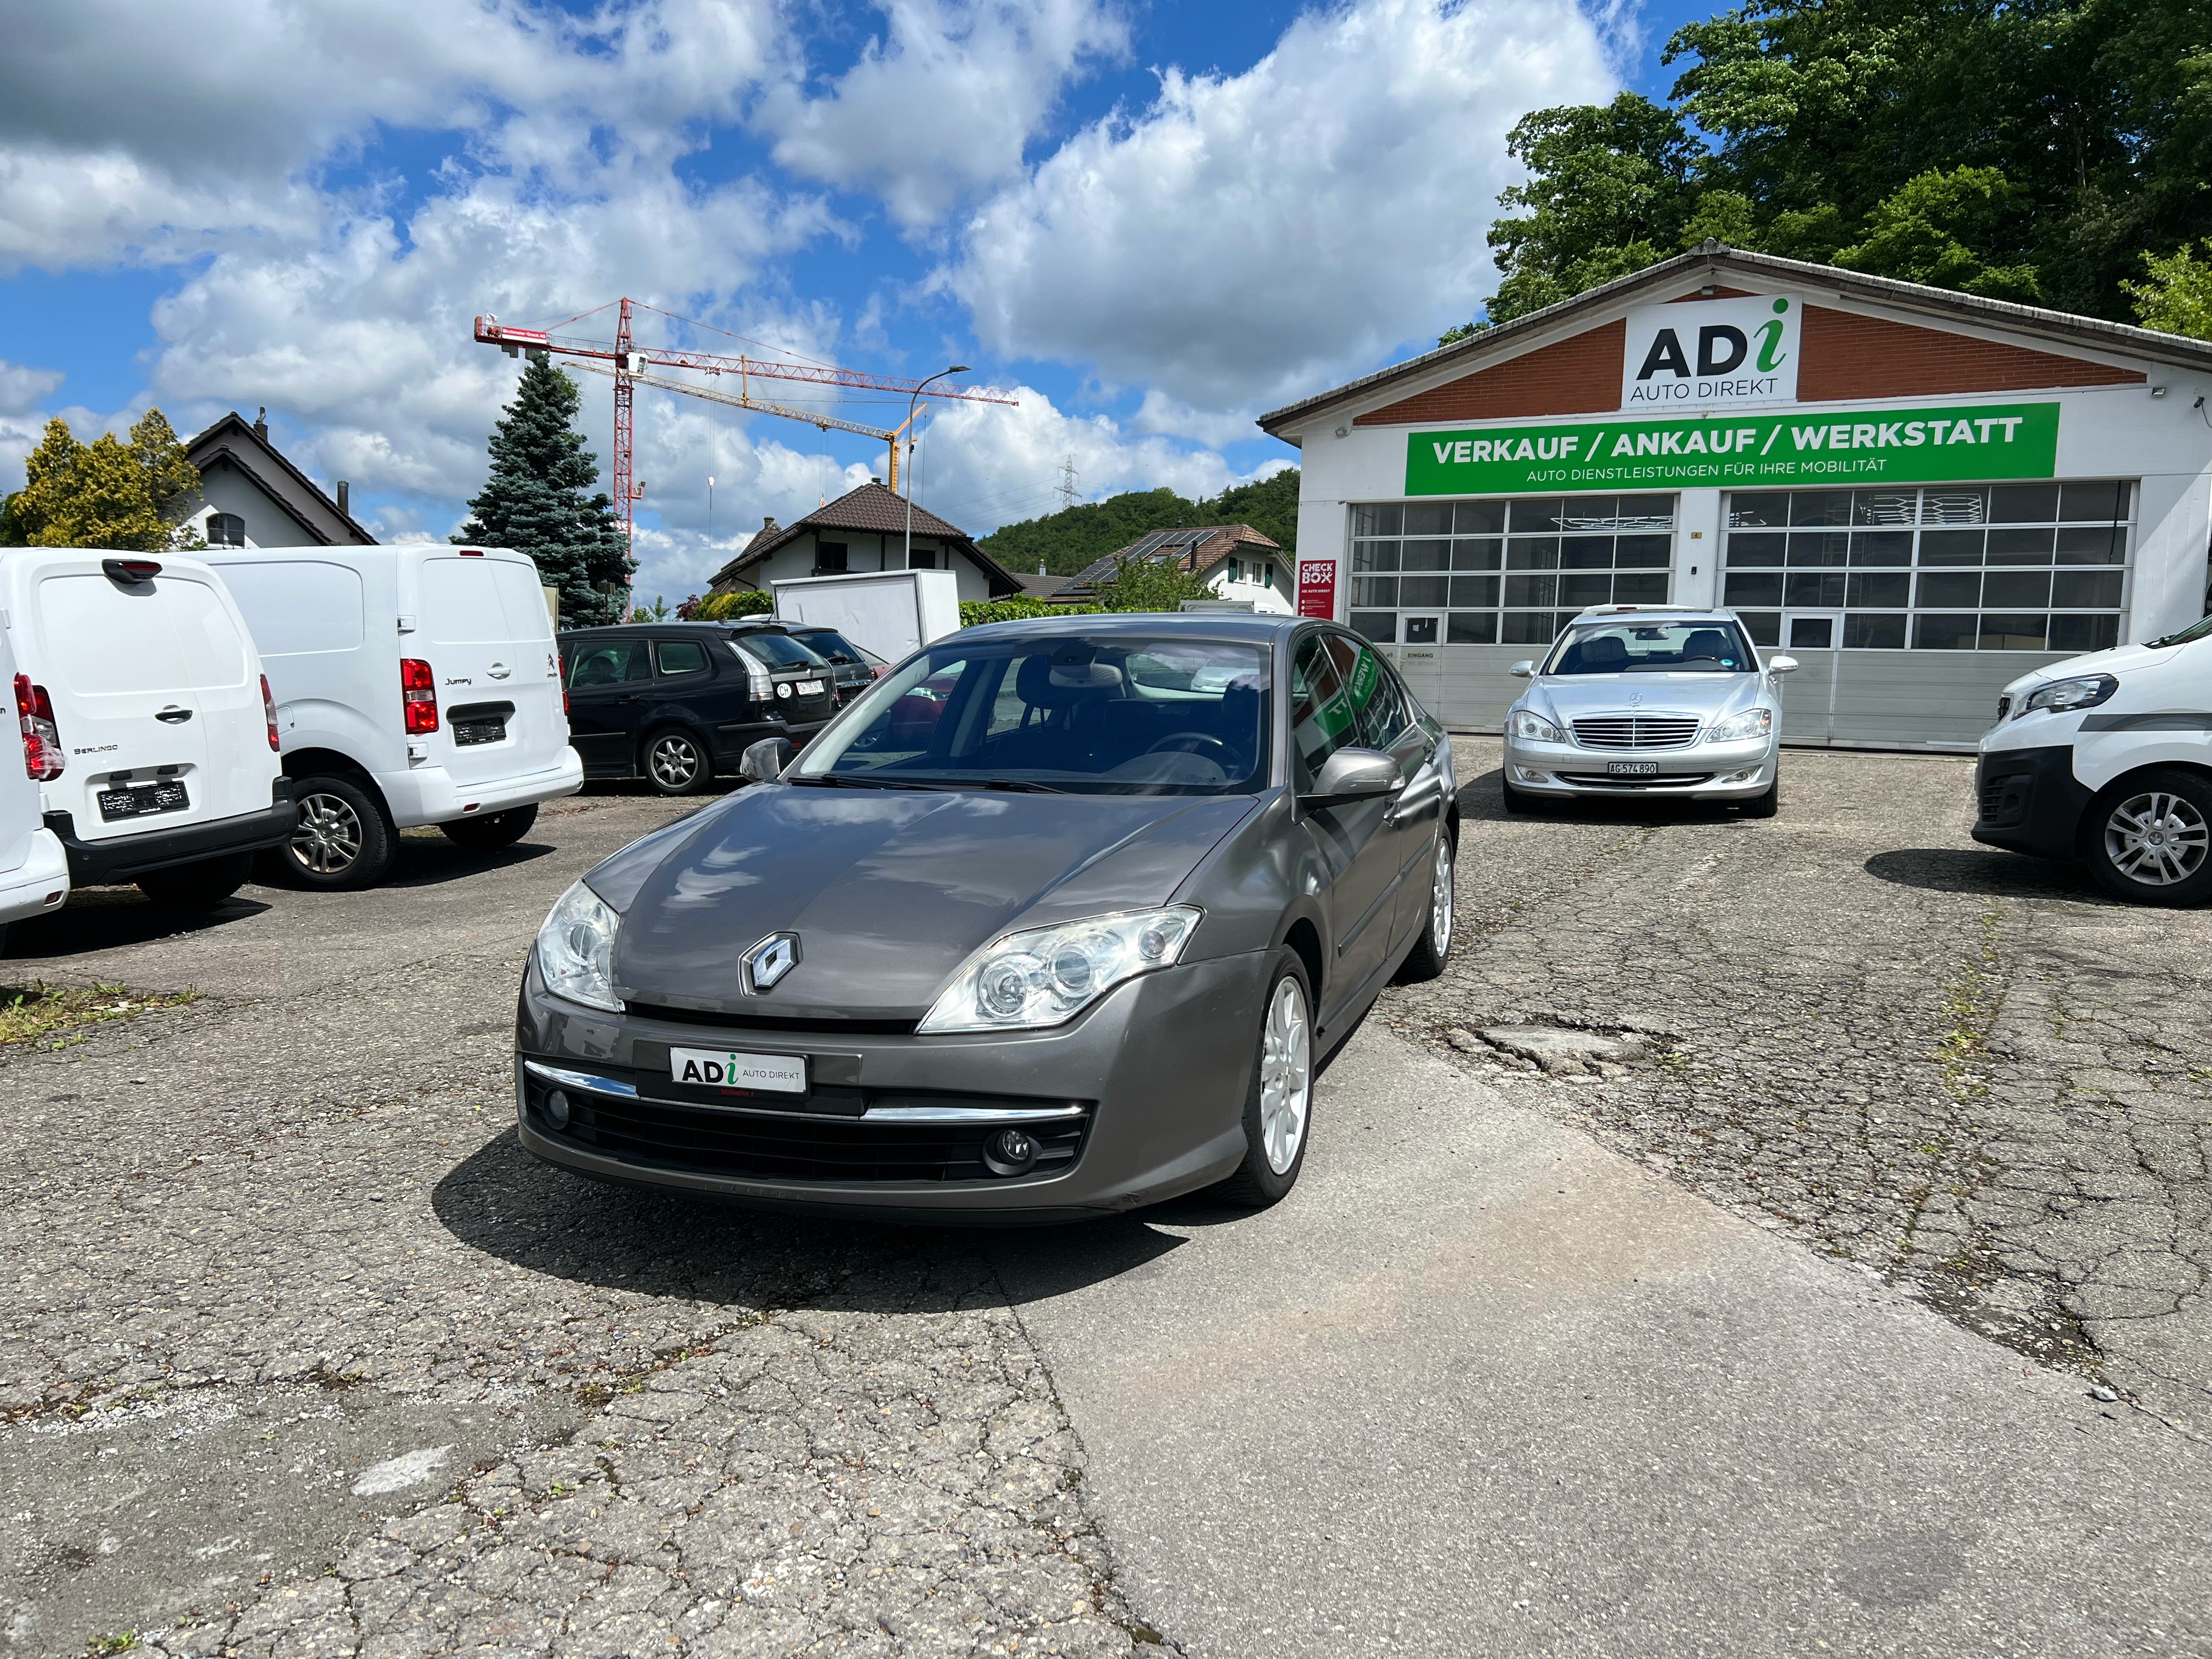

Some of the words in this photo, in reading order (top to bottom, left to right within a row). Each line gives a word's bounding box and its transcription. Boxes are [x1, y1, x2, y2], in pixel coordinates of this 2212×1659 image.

[1636, 298, 1789, 380] ADi
[1630, 383, 1689, 402] AUTO
[1698, 378, 1778, 398] DIREKT
[1432, 436, 1578, 464] VERKAUF
[1611, 428, 1757, 457] ANKAUF
[1791, 417, 2023, 450] WERKSTATT
[1527, 470, 1567, 482] AUTO
[1571, 464, 1719, 481] DIENSTLEISTUNGEN
[1724, 462, 1755, 476] FÜR
[1760, 462, 1796, 475] IHRE
[1801, 458, 1887, 473] MOBILITÄT
[1302, 563, 1333, 572] CHECK
[1302, 572, 1333, 584] BOX
[780, 685, 789, 696] CH
[74, 744, 118, 755] BERLINGO
[682, 1053, 739, 1085] ADi
[742, 1069, 766, 1078] AUTO
[769, 1071, 800, 1080] DIREKT
